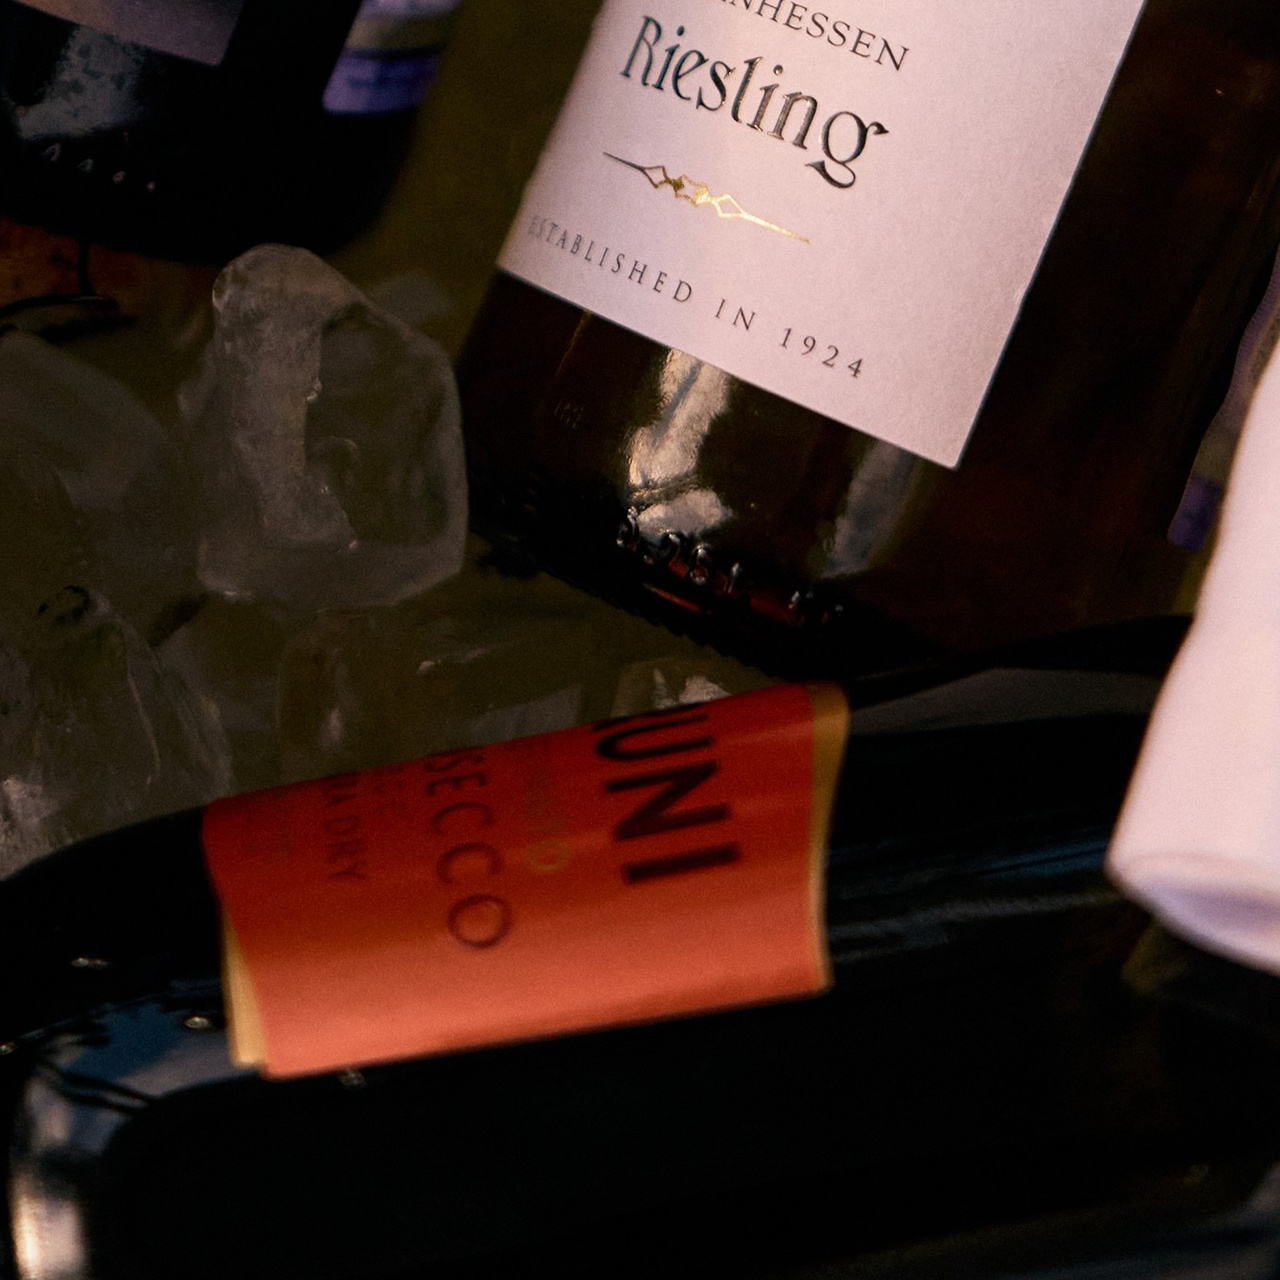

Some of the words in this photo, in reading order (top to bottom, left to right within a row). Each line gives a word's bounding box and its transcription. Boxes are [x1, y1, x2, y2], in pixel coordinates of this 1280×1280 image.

[620, 14, 889, 189] Riesling
[528, 214, 693, 303] ESTABLISHED
[714, 298, 756, 331] IN
[780, 326, 864, 379] 1924
[593, 702, 741, 884] UNI
